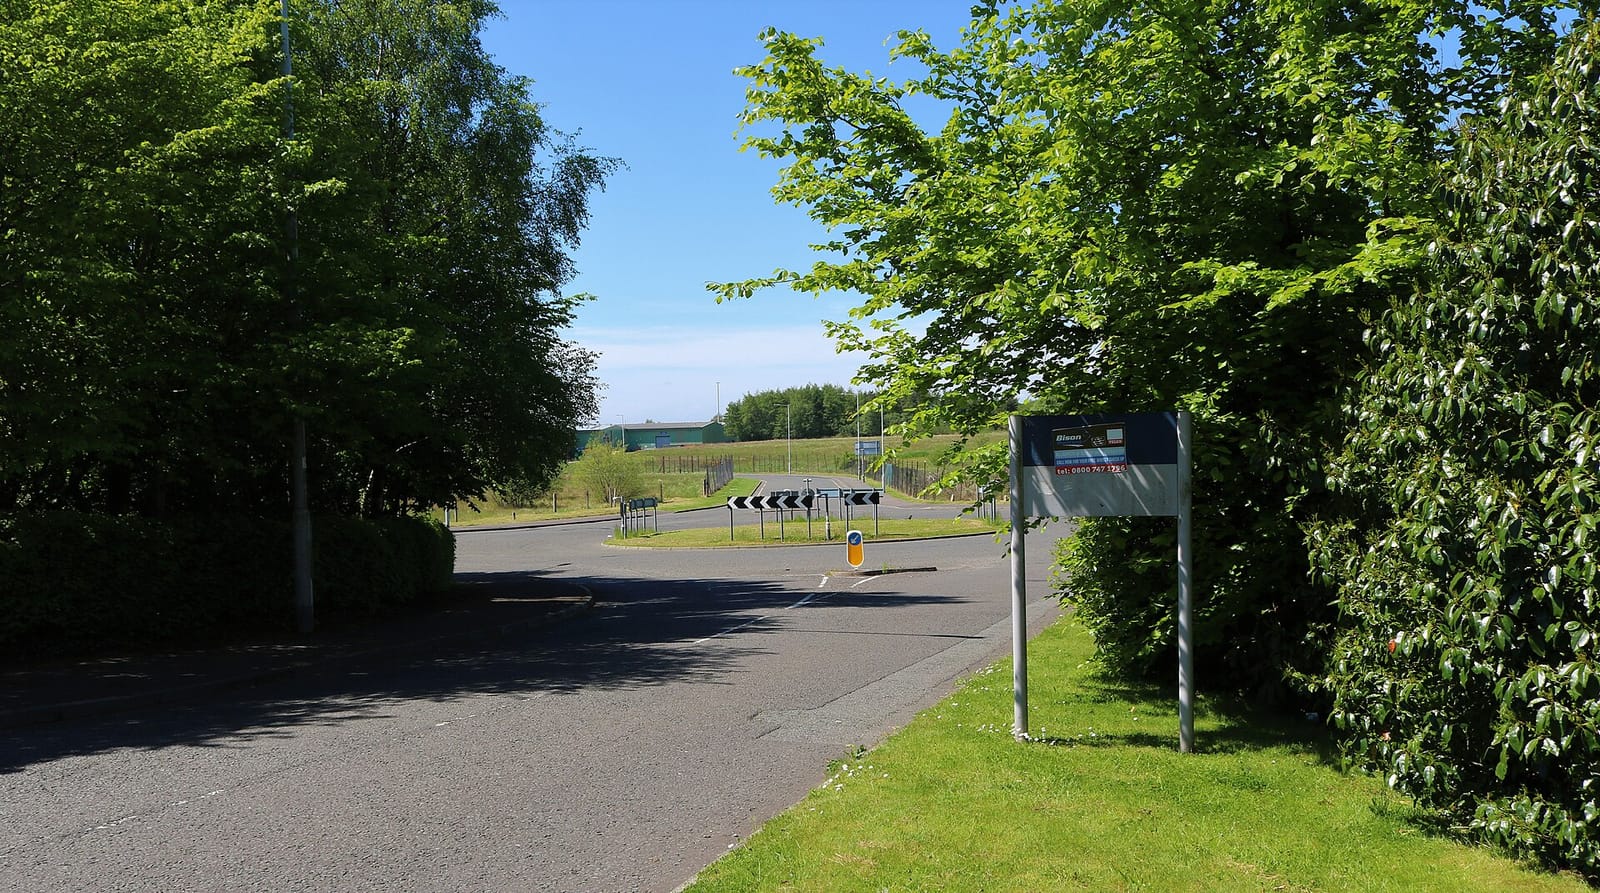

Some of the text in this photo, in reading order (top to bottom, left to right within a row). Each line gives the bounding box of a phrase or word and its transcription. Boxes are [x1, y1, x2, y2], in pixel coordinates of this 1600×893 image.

[1056, 434, 1082, 442] Bison
[1057, 467, 1070, 475] tel:
[1071, 466, 1091, 474] 0800
[1091, 465, 1106, 473] 747
